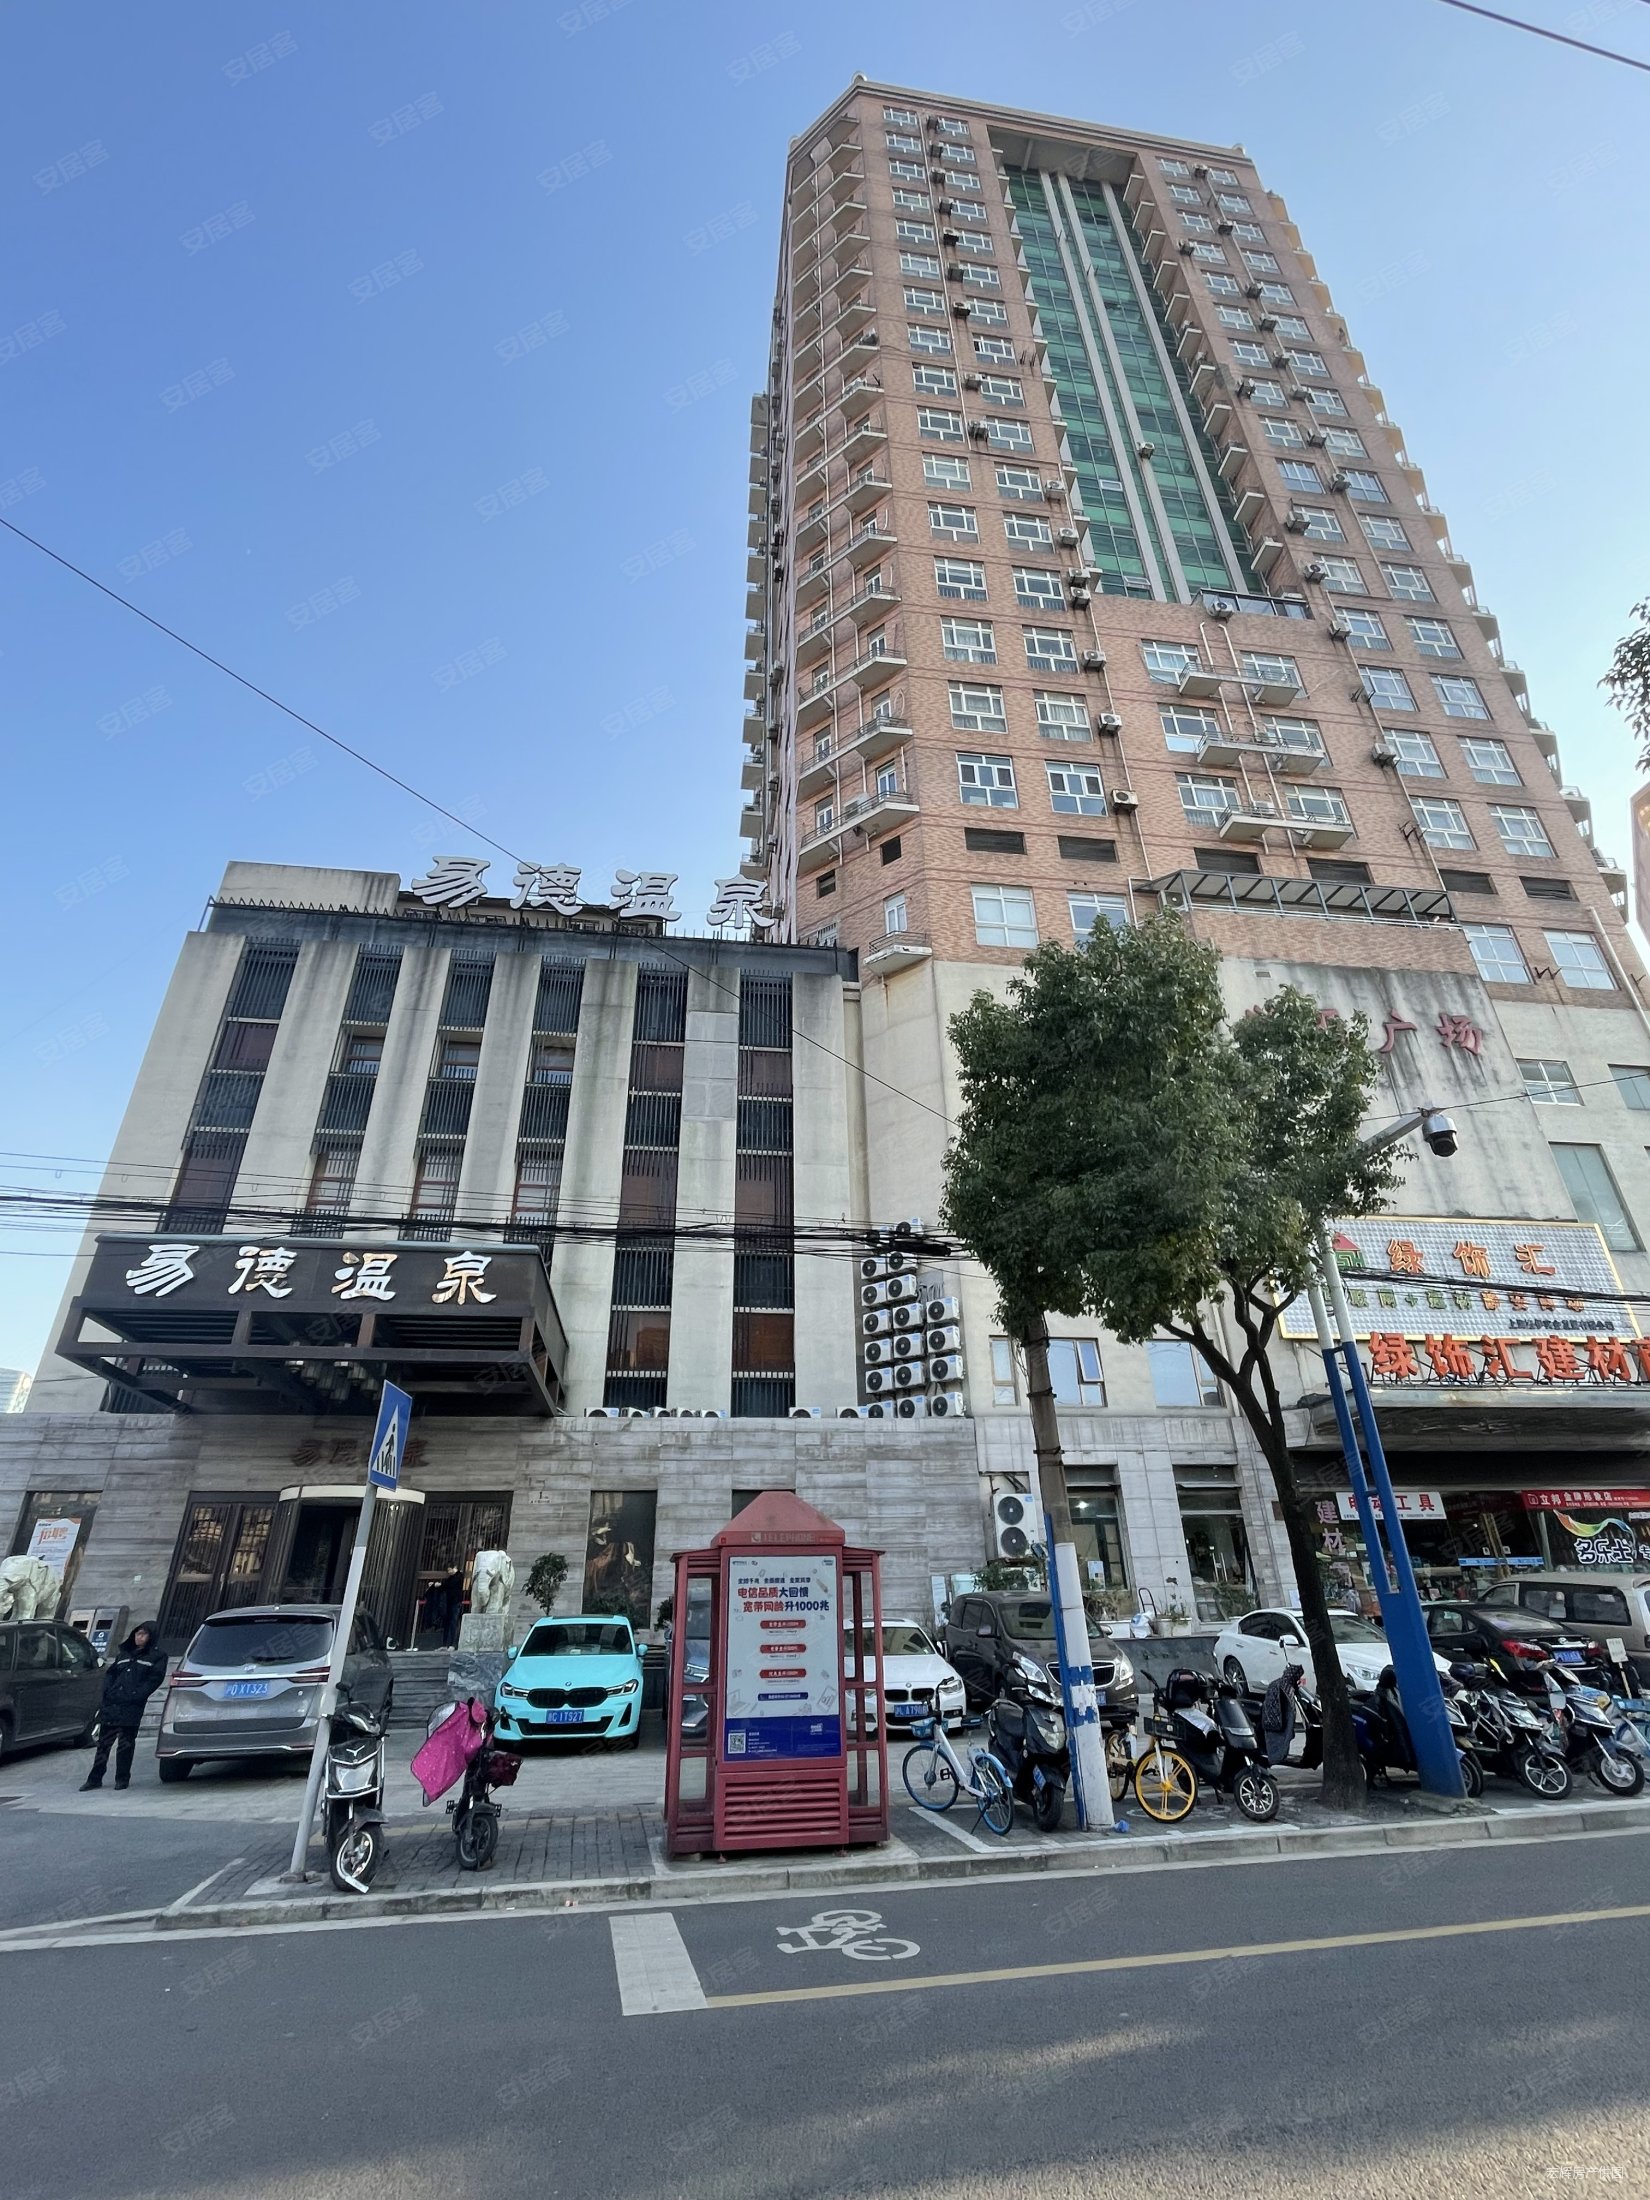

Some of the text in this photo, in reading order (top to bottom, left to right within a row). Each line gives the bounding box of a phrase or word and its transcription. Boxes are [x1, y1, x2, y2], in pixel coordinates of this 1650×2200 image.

[411, 856, 776, 929] 易德温泉
[126, 1243, 497, 1305] 易德温泉
[1387, 1238, 1557, 1278] 绿饰汇
[291, 1437, 430, 1468] 易德泉
[1574, 1538, 1634, 1564] 多乐士
[738, 1587, 809, 1598] 电信品质大回馈
